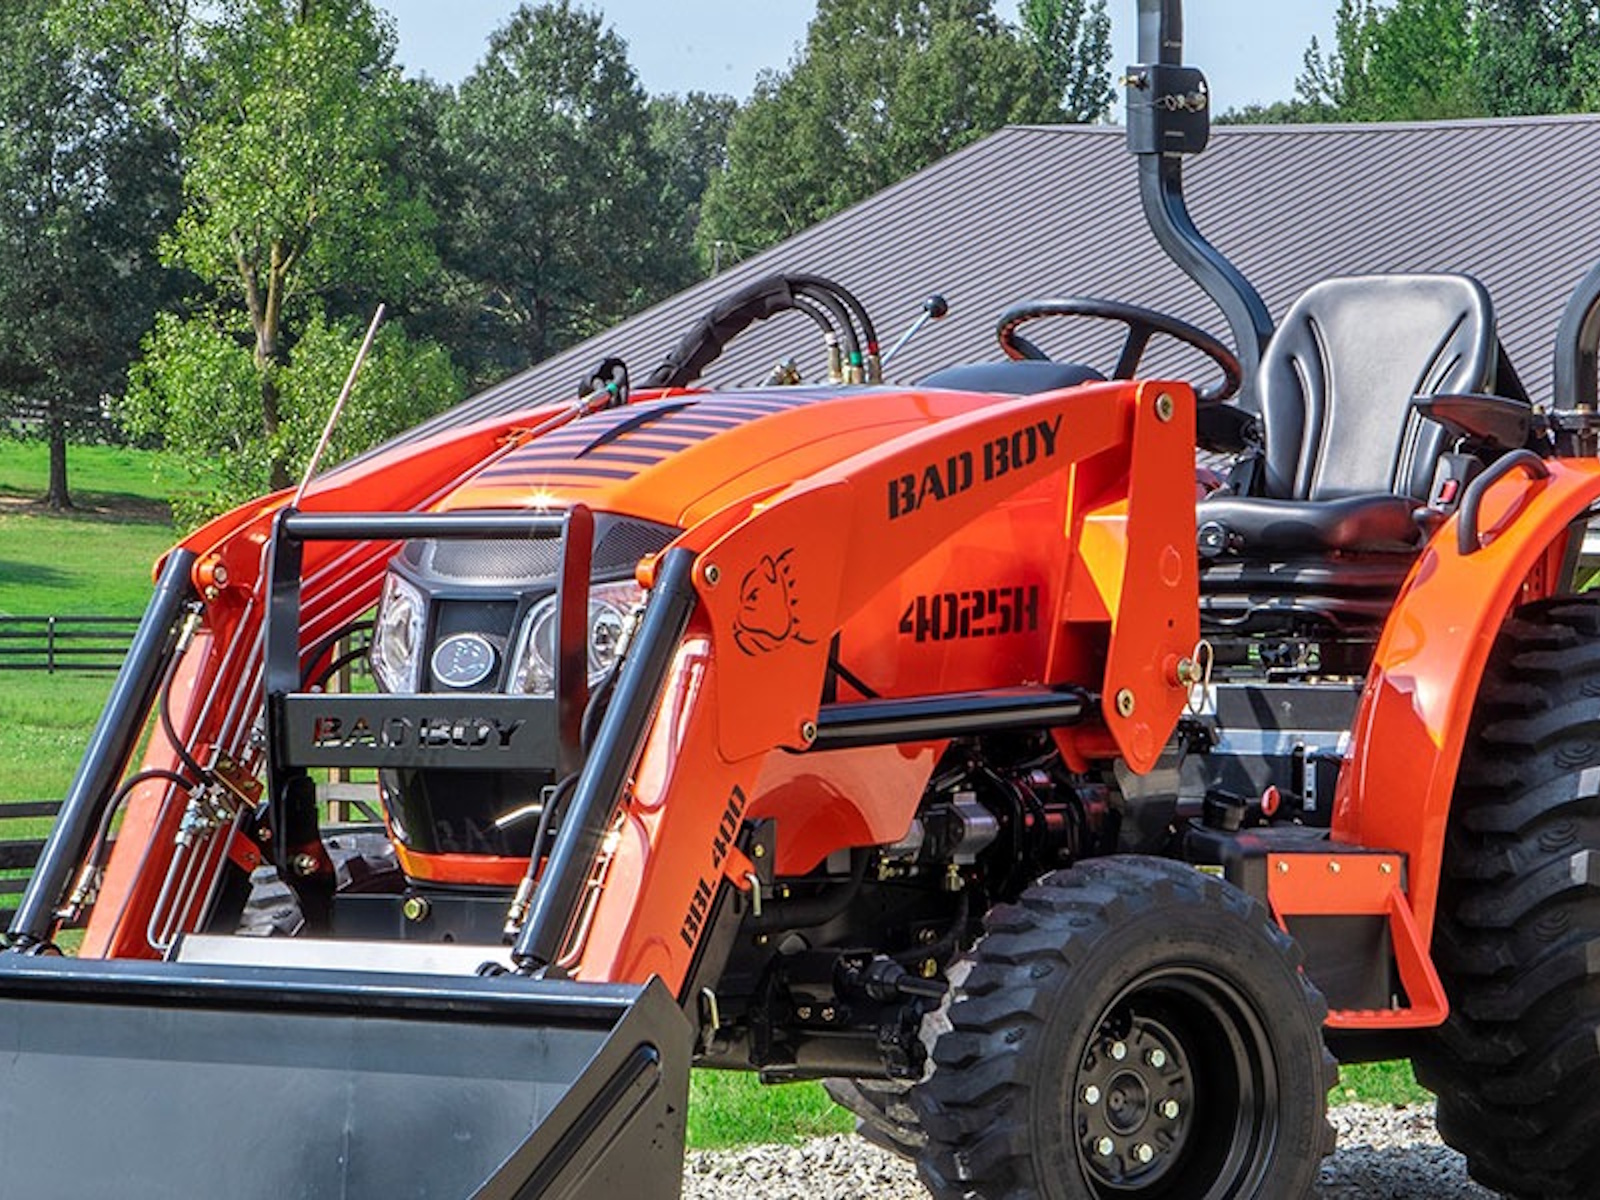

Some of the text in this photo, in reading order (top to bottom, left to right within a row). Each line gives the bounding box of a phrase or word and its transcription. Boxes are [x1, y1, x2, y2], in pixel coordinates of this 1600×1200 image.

[888, 413, 1063, 520] BAD BOY
[898, 585, 1038, 643] 4025H
[418, 717, 526, 750] BOY
[680, 784, 746, 949] BBL 400
